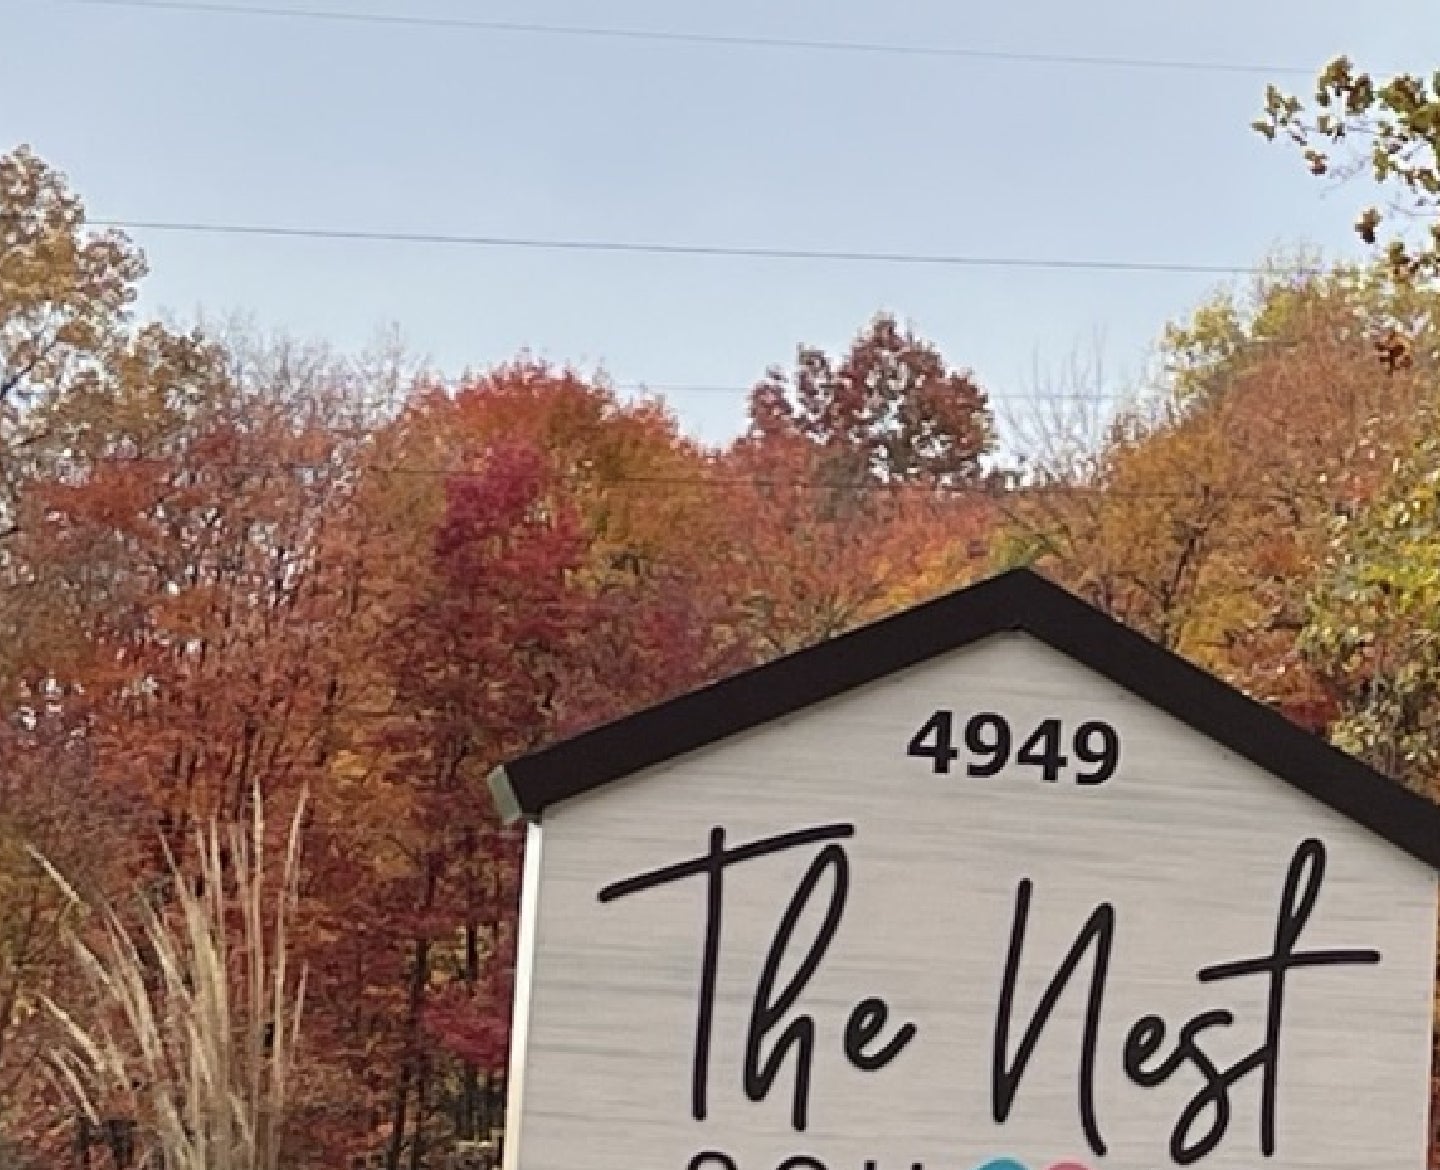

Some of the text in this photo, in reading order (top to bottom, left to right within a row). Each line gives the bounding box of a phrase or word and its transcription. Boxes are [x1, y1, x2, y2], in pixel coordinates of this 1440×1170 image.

[907, 710, 1120, 785] 4949
[599, 824, 1381, 1166] The Nest
